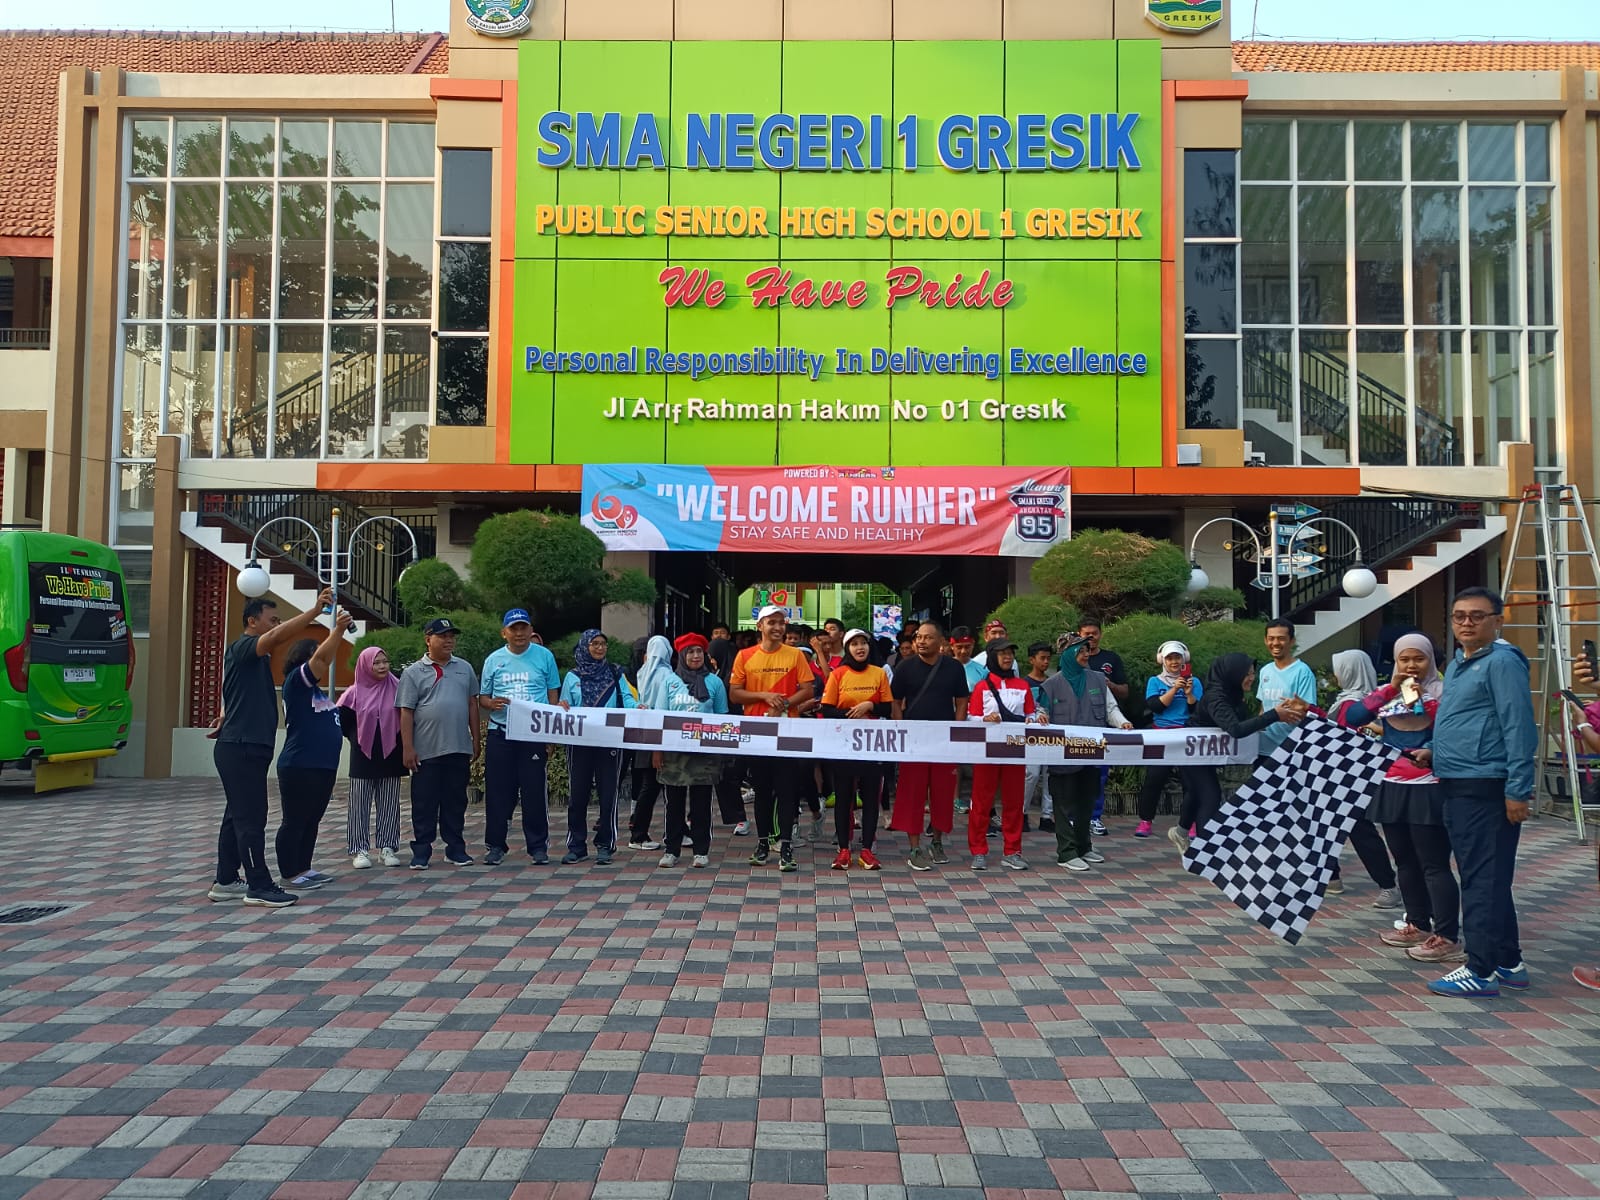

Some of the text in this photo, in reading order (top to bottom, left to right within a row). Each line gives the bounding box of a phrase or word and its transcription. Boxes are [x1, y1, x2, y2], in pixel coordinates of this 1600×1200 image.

[537, 111, 1141, 172] SMA NEGERI 1 GRESIK
[536, 204, 1142, 238] PUBLIC SENIOR HIGH SCHOOL 1 GRESIK
[658, 265, 1014, 308] We Have Pride
[525, 346, 1147, 381] Personal Responsibility In Delivering Excellence
[687, 398, 792, 420] Rahman
[801, 399, 880, 420] Hakim
[893, 399, 928, 420] No
[941, 399, 969, 420] 01
[980, 398, 1067, 421] Gresik
[784, 468, 818, 478] POWERED
[820, 469, 829, 478] BY
[1006, 478, 1065, 494] Alumni
[657, 483, 996, 526] "WELCOME RUNNER"
[730, 526, 925, 541] STAY SAFE AND HEALTHY
[1021, 515, 1053, 535] 95
[45, 575, 112, 599] We Have Pride
[760, 590, 768, 605] I
[502, 671, 529, 684] RUN
[531, 709, 587, 736] START
[852, 728, 908, 752] START
[1007, 734, 1097, 748] INDORUNNERS
